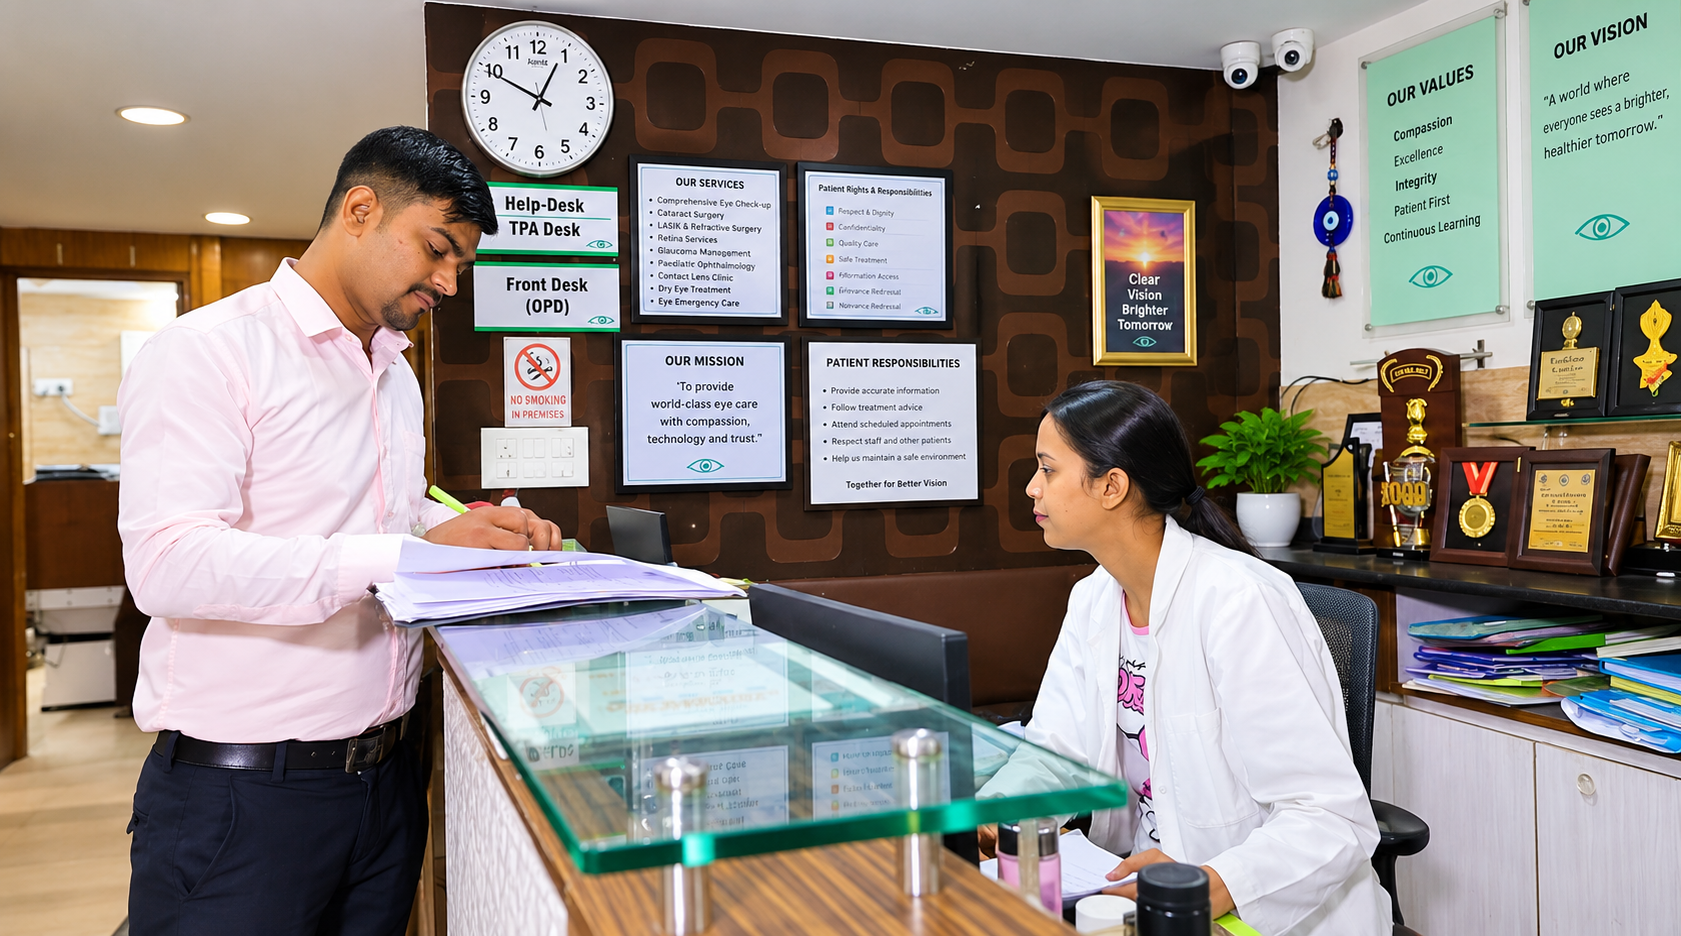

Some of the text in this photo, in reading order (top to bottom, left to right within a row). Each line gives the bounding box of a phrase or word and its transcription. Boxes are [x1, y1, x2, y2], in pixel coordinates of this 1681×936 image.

[1554, 12, 1647, 59] OUR VISION
[506, 45, 519, 59] 11
[530, 40, 546, 54] 12
[561, 49, 567, 63] 1
[484, 63, 504, 80] 10
[578, 69, 588, 84] 2
[1388, 65, 1473, 106] OUR VALUES
[1559, 82, 1590, 102] world
[1594, 72, 1629, 91] where
[481, 90, 490, 104] 9
[586, 97, 595, 110] 3
[1544, 89, 1669, 133] everyone sees a brighter,
[489, 117, 498, 131] 8
[579, 122, 588, 136] 4
[1394, 116, 1452, 141] Compassion
[508, 137, 518, 150] 7
[561, 139, 570, 153] 5
[1545, 138, 1592, 159] healthier
[535, 145, 544, 159] 6
[1395, 146, 1443, 167] Excellence
[676, 177, 744, 189] OUR SERVICES
[1396, 173, 1437, 191] Integrity
[819, 184, 844, 192] Patient
[847, 185, 869, 195] Rights
[506, 196, 584, 215] Help-Desk
[657, 196, 771, 210] Comprehensive Eye Check-up
[1395, 195, 1450, 216] Patient First
[657, 209, 724, 220] Cataract Surgery
[872, 209, 894, 218] Dignity
[509, 221, 580, 236] TPA Desk
[691, 223, 730, 231] Refractive
[732, 225, 762, 234] Surgery
[1384, 215, 1480, 243] Continuous Learning
[658, 234, 717, 243] Retina Services
[839, 240, 862, 248] Quality
[658, 247, 751, 257] Glaucoma Management
[697, 261, 755, 271] Ophthalmology
[658, 272, 689, 280] Contact
[691, 273, 710, 281] Lens
[1129, 273, 1160, 285] Clear
[507, 277, 588, 292] Front Desk
[659, 285, 672, 294] Dry
[675, 285, 688, 294] Eye
[1128, 288, 1161, 300] Vision
[526, 299, 569, 316] (OPD)
[659, 297, 739, 308] Eye Emergency Care
[1123, 304, 1168, 318] Brighter
[1118, 319, 1173, 330] Tomorrow
[666, 356, 744, 366] OUR MISSION
[827, 358, 960, 368] PATIENT RESPONSIBILITIES
[696, 382, 734, 393] provide
[511, 395, 566, 405] NO SMOKING
[651, 399, 711, 408] world-class
[714, 401, 732, 411] eye
[832, 403, 856, 411] Follow
[898, 403, 923, 411] advice
[523, 410, 564, 419] PREMISES
[660, 416, 750, 428] with compassion,
[860, 420, 898, 428] scheduled
[900, 420, 952, 429] appointments
[648, 434, 706, 445] technology
[709, 434, 727, 443] and
[832, 438, 862, 446] Respect
[922, 437, 951, 446] patients
[832, 455, 849, 463] Help
[904, 453, 919, 461] safe
[846, 481, 881, 490] Together
